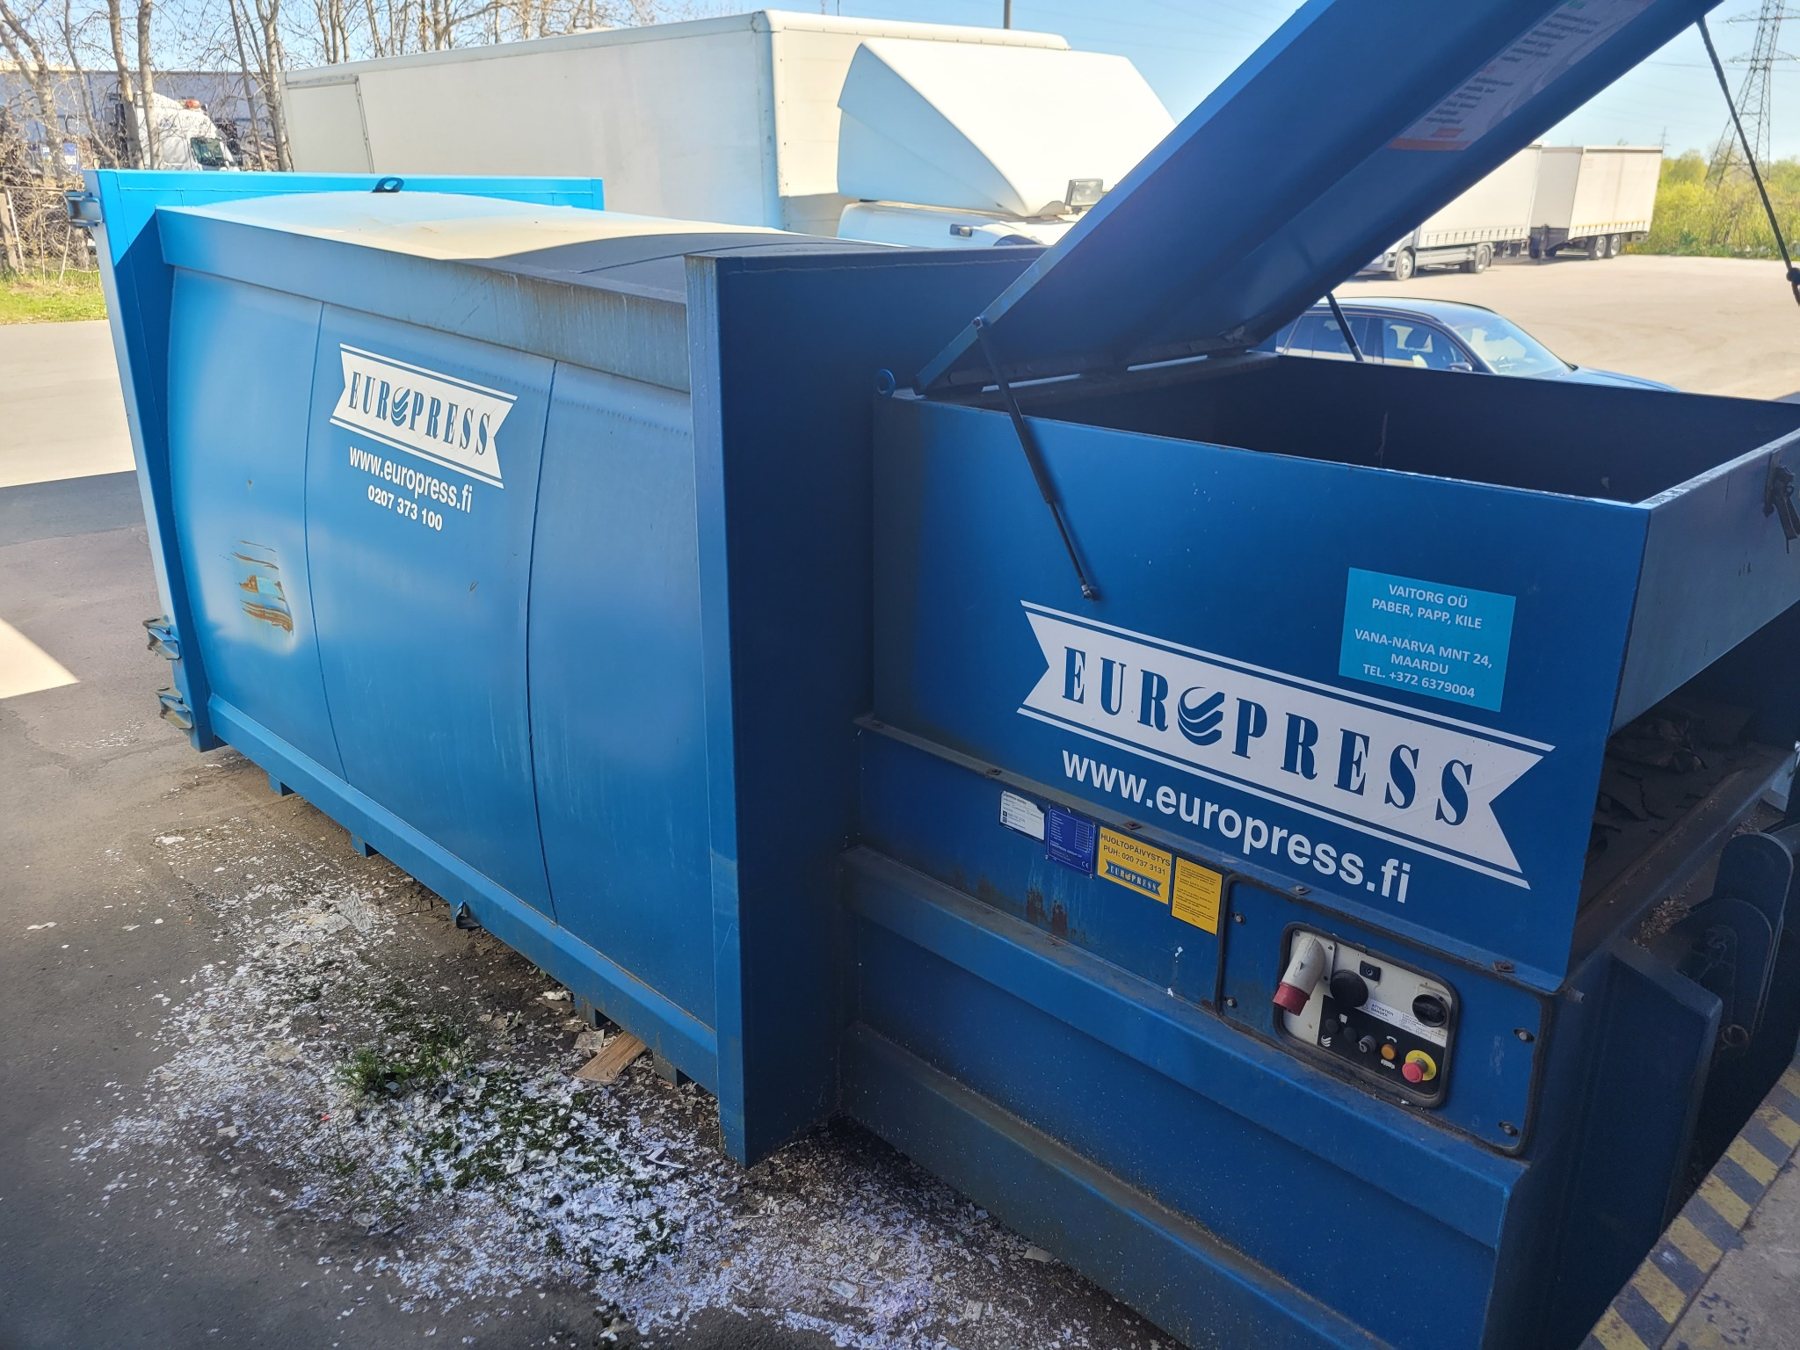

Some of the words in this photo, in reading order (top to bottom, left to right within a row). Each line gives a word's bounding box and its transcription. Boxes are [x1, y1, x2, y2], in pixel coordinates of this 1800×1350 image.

[348, 371, 491, 455] EUROPRESS
[350, 446, 473, 513] www.europress.fi
[368, 485, 394, 509] 0207
[397, 498, 417, 520] 373
[422, 508, 443, 531] 100
[1372, 598, 1414, 617] PABER,
[1417, 607, 1451, 625] PAPP,
[1455, 614, 1483, 629] KILE
[1389, 584, 1444, 604] VAITORG
[1447, 594, 1468, 608] OÜ
[1354, 628, 1435, 655] VANA-NARVA
[1439, 646, 1471, 662] MNT
[1472, 653, 1493, 669] 24,
[1391, 653, 1449, 675] MAARDU
[1363, 663, 1385, 678] TEL.
[1389, 671, 1418, 685] +372
[1421, 677, 1475, 698] 6379004
[1062, 645, 1473, 826] EUROPRESS
[1062, 749, 1412, 904] www.europress.fi
[1110, 865, 1157, 892] EUROPRESS
[1121, 852, 1134, 863] 020
[1135, 858, 1148, 868] 737
[1149, 864, 1166, 876] 3131
